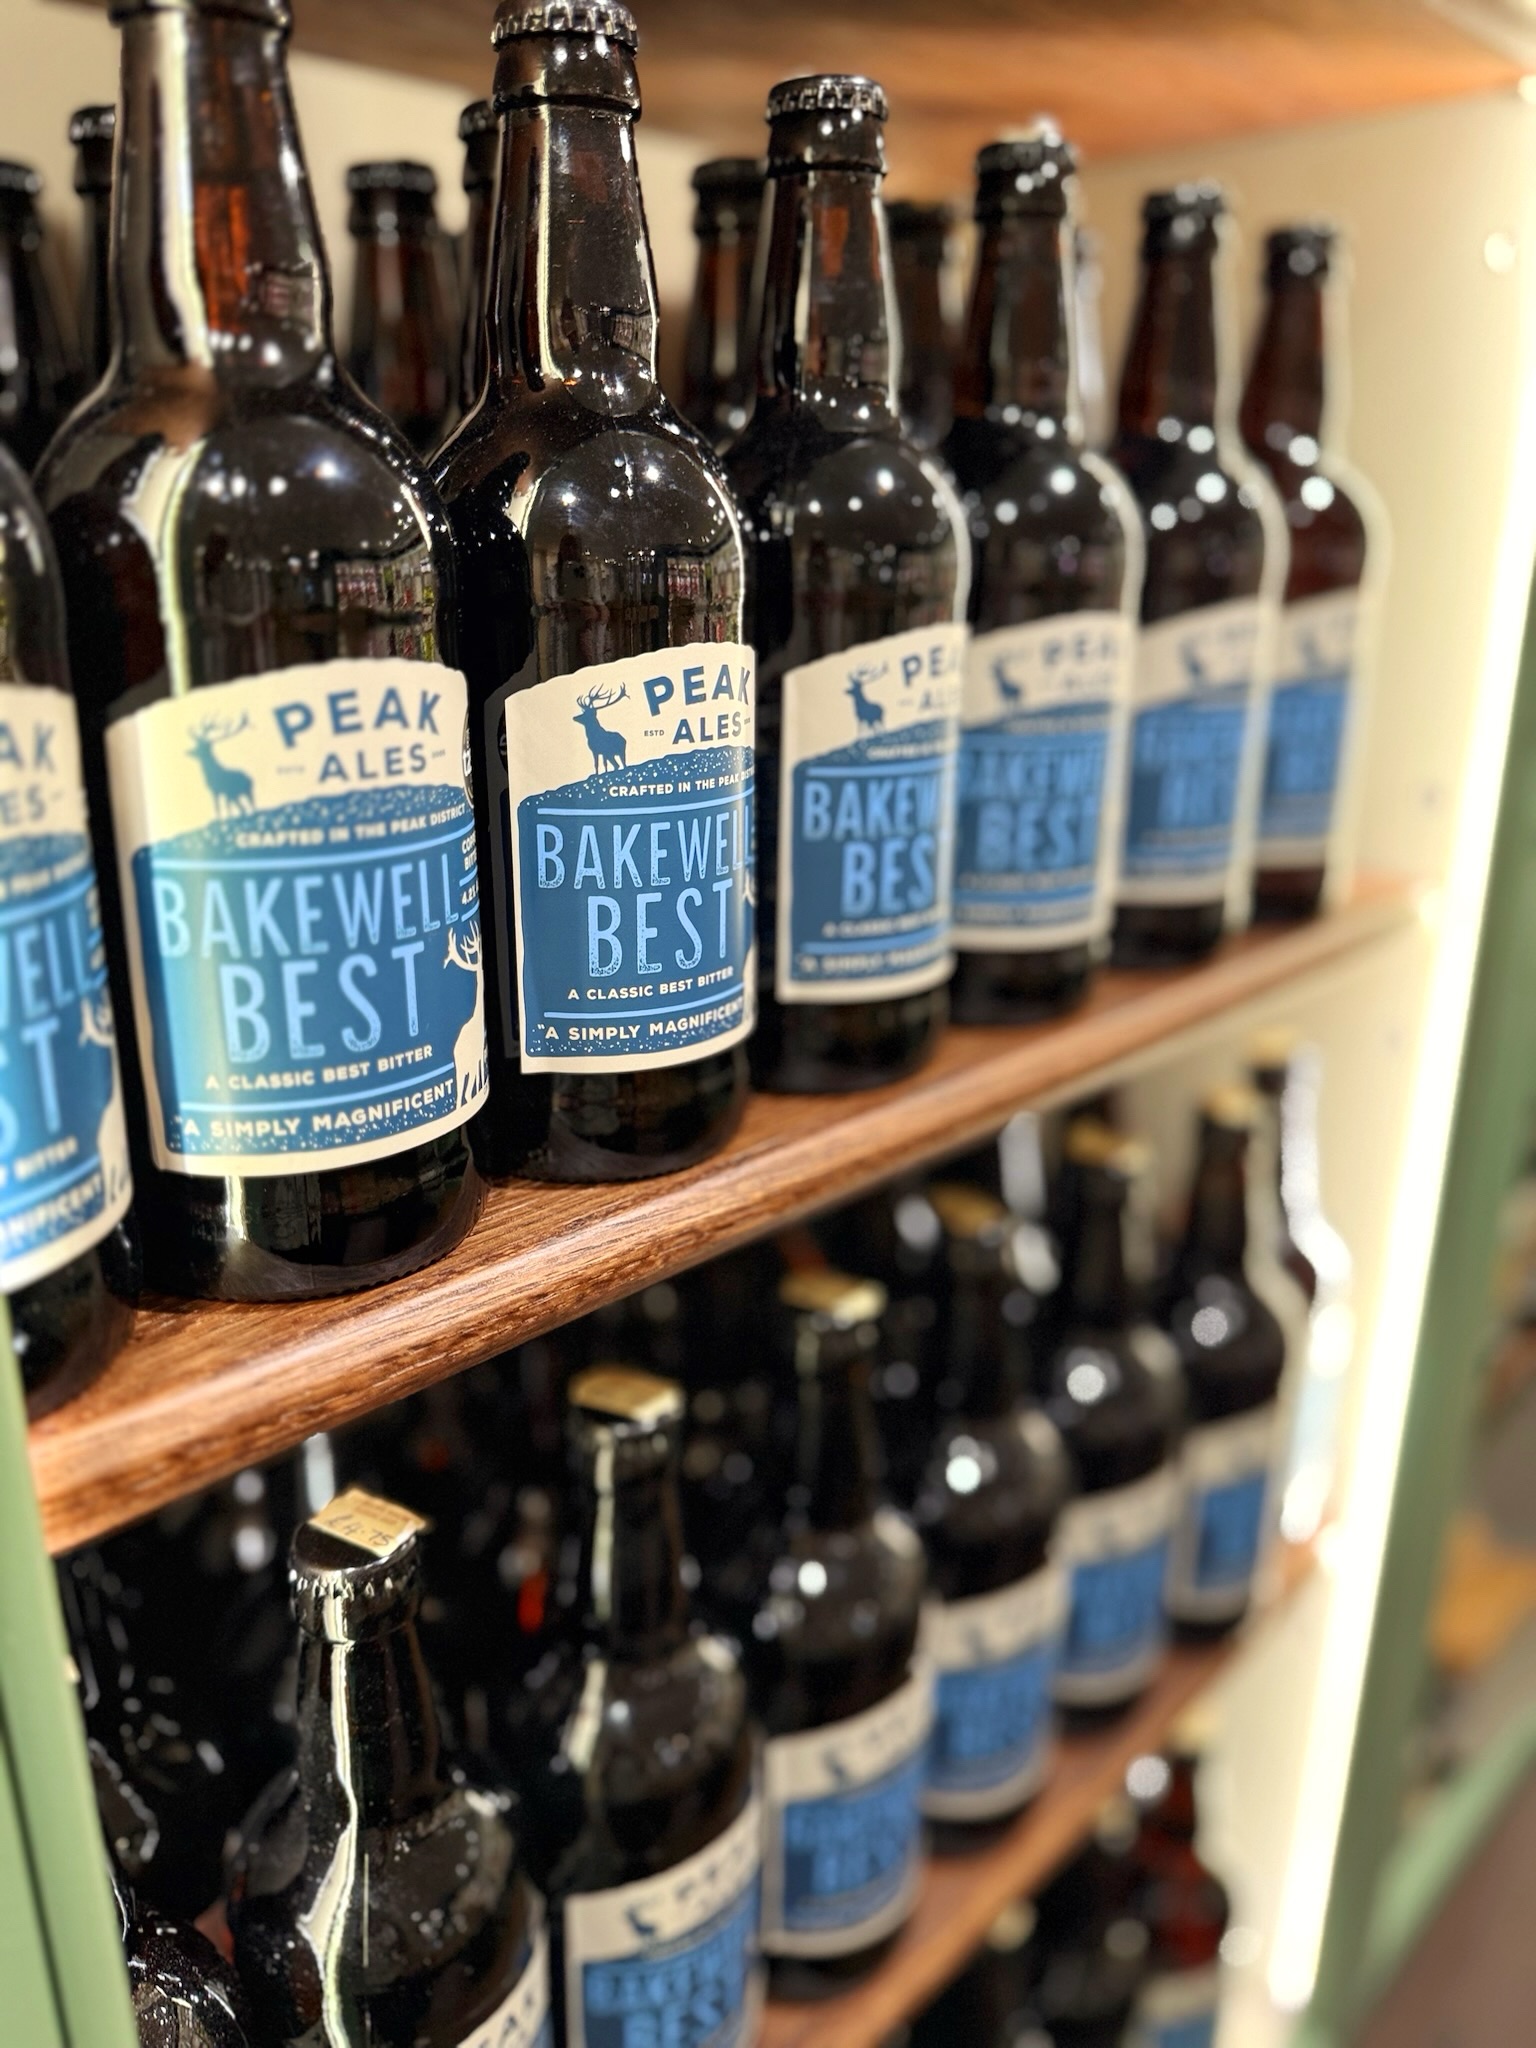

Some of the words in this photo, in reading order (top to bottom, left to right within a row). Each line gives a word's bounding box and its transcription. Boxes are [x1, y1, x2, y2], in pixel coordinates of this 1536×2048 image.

[643, 664, 750, 717] PEAK
[273, 686, 441, 749] PEAK
[672, 711, 742, 745] ALES
[317, 743, 427, 784] ALES
[609, 783, 674, 798] CRAFTED
[678, 781, 691, 793] IN
[695, 778, 716, 790] THE
[719, 773, 740, 788] PEAK
[235, 828, 323, 849] CRAFTED
[328, 824, 349, 844] IN
[354, 820, 386, 840] THE
[390, 816, 428, 834] PEAK
[430, 801, 466, 828] DISTRICT
[153, 853, 459, 959] BAKEWELL
[587, 878, 733, 977] BEST
[220, 940, 425, 1063] BEST
[568, 989, 580, 1000] A
[586, 985, 653, 1000] CLASSIC
[659, 979, 694, 995] BEST
[698, 966, 734, 987] BITTER
[568, 1025, 641, 1041] SIMPLY
[205, 1073, 219, 1091] A
[229, 1070, 315, 1090] CLASSIC
[322, 1061, 370, 1084] BEST
[378, 1045, 433, 1073] BITTER
[210, 1117, 300, 1138] SIMPLY
[313, 1079, 454, 1132] MAGNIFICENT
